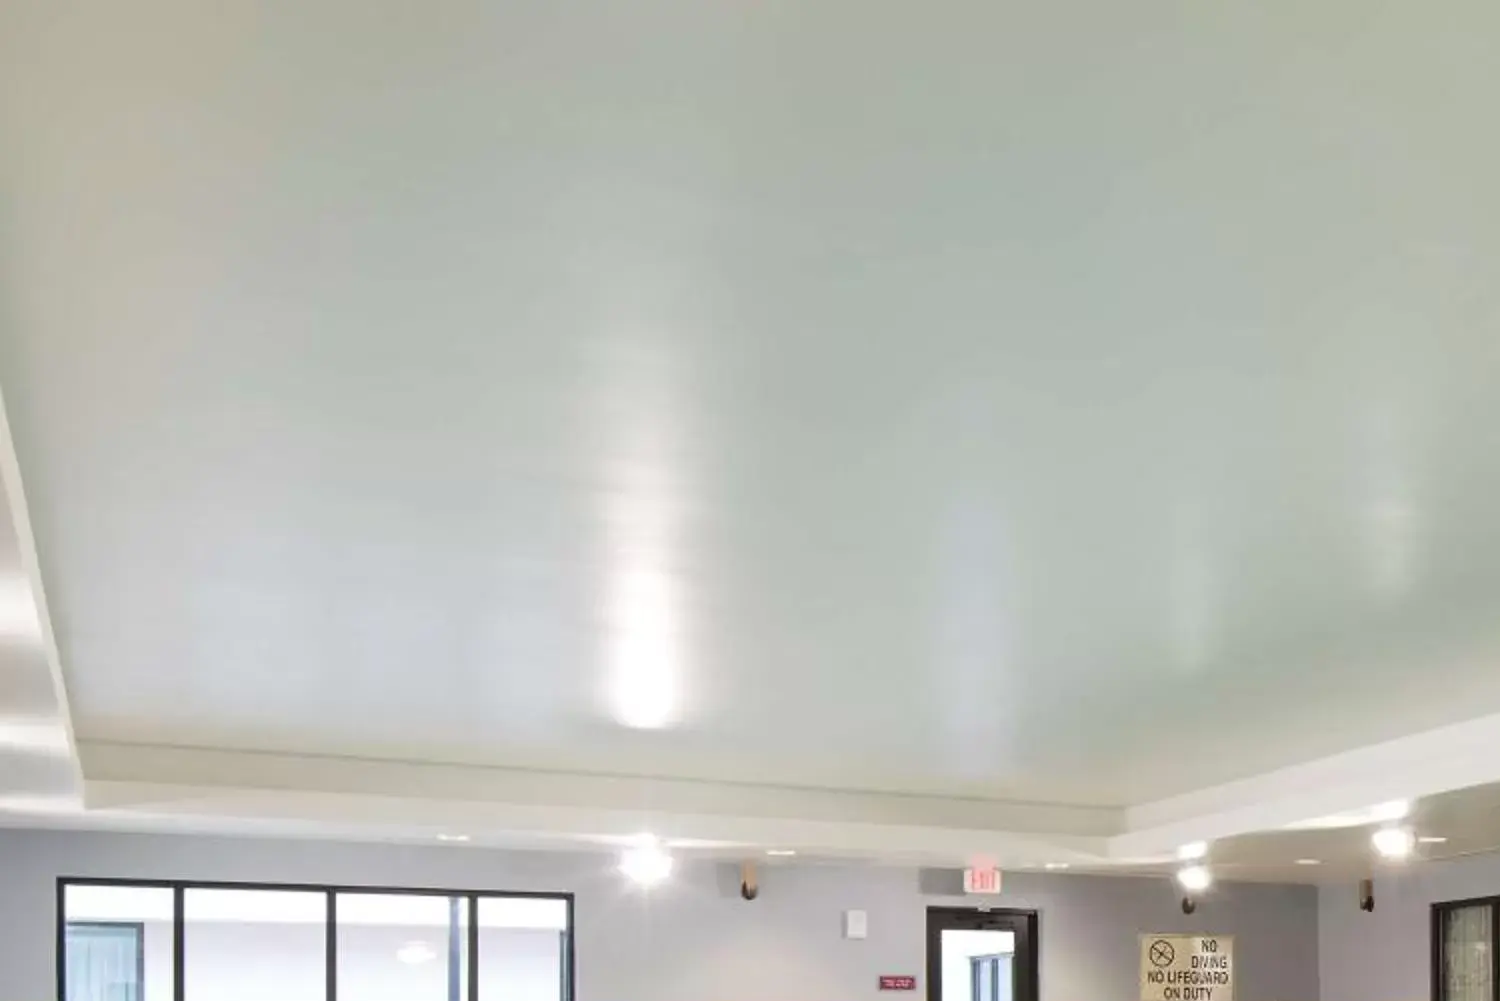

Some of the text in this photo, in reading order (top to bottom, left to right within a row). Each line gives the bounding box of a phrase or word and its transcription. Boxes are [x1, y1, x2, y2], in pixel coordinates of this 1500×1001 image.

[1201, 939, 1217, 953] NO
[1191, 955, 1227, 969] DIVING
[1147, 970, 1229, 985] NO LIFEGUARD
[1163, 987, 1213, 1001] ON DUTY
